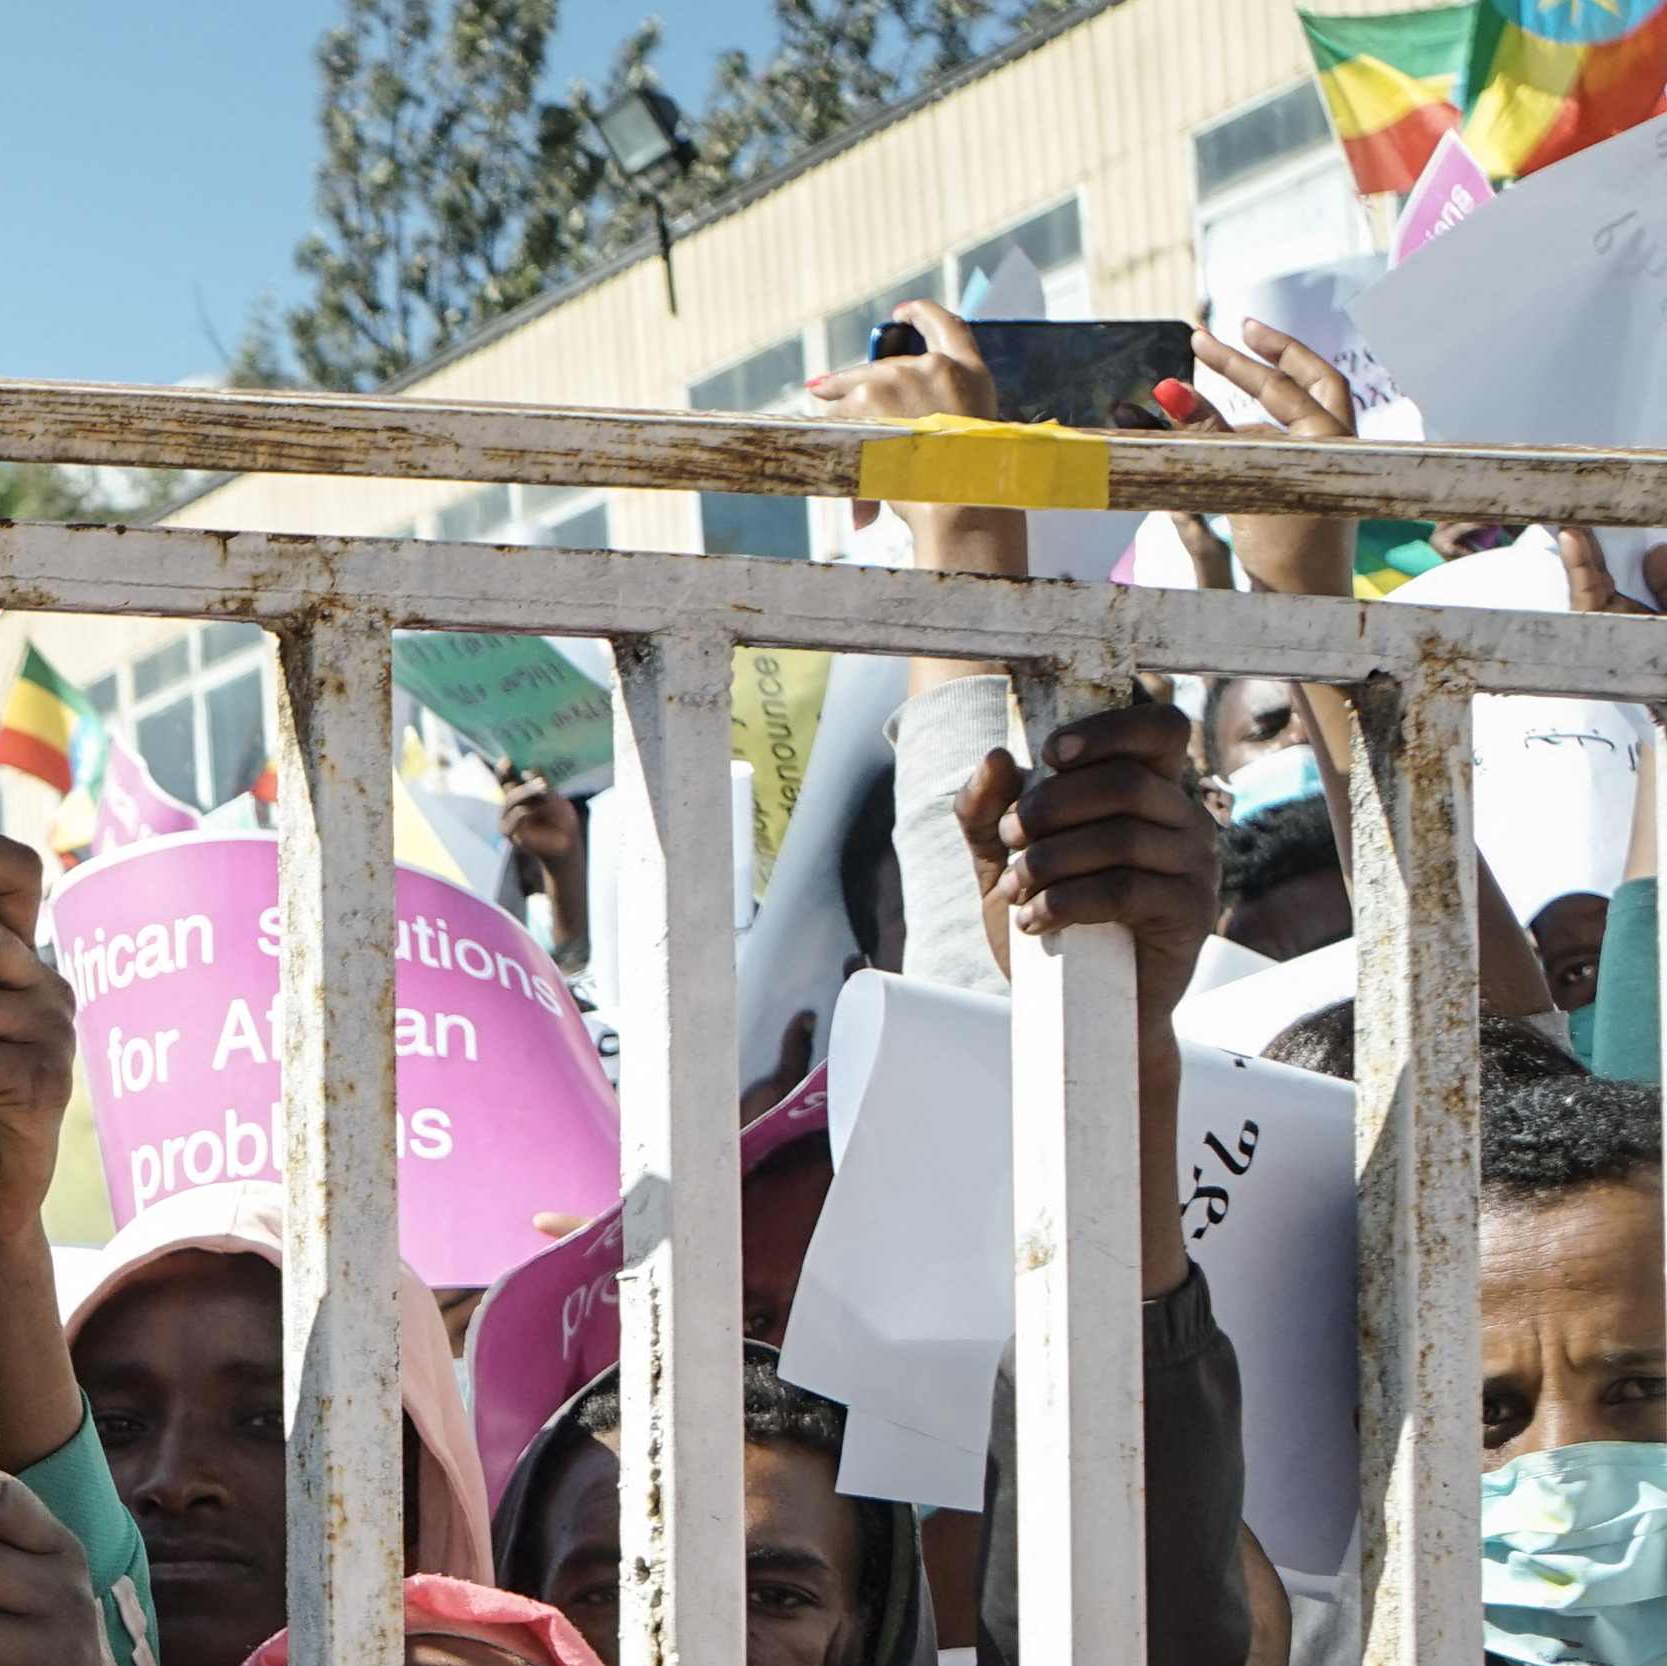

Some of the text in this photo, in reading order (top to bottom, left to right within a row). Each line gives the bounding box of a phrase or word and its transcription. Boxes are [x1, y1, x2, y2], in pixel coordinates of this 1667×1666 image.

[106, 992, 479, 1097] for Afan
[130, 1101, 455, 1216] probls
